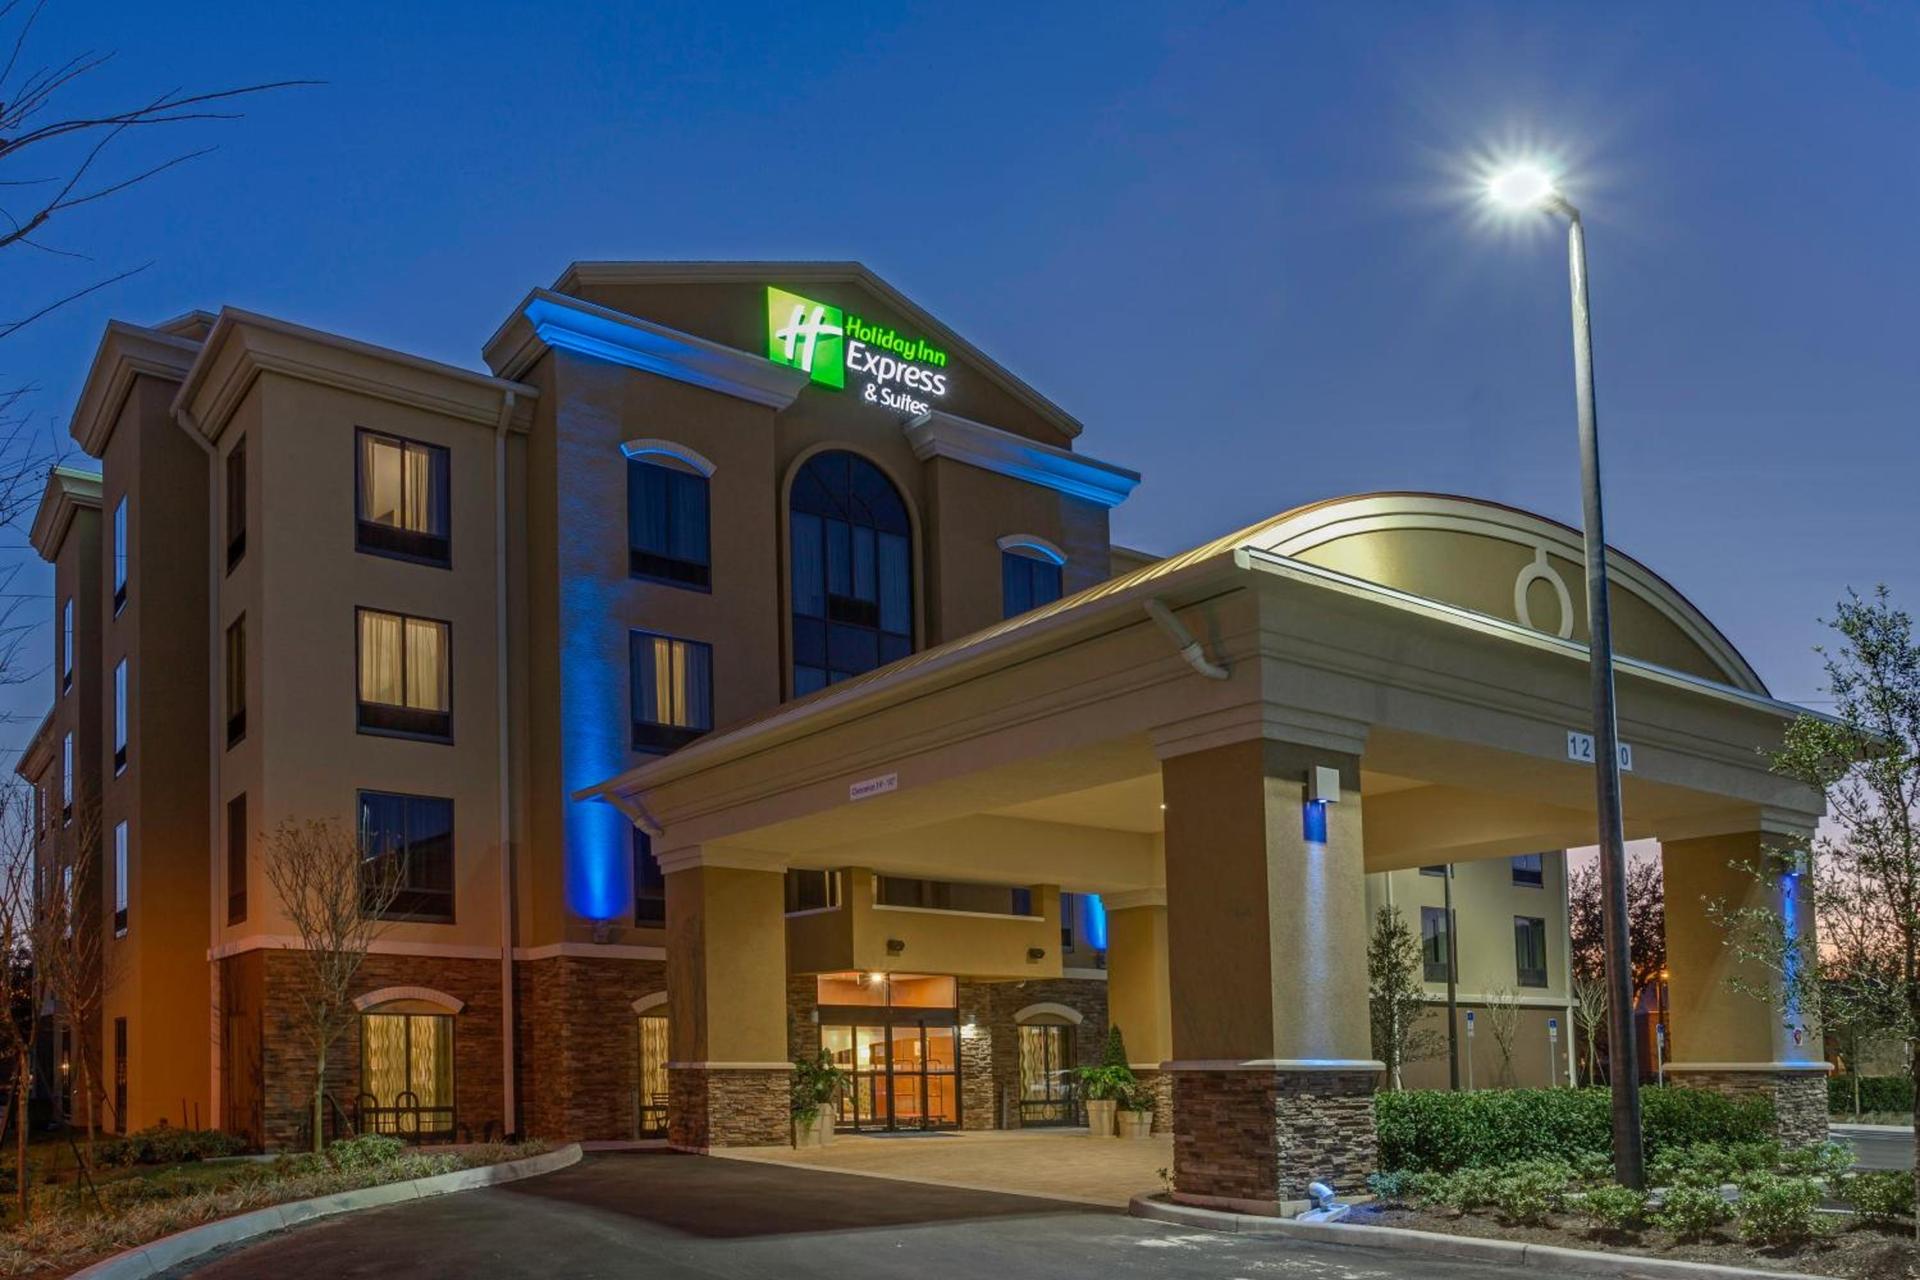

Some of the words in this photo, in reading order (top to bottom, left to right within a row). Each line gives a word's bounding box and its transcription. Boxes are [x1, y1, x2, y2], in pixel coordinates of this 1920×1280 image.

[846, 315, 916, 361] Holiday
[918, 339, 947, 367] Inn
[846, 340, 947, 396] Express
[864, 382, 878, 402] &
[880, 387, 930, 416] Suites
[1570, 735, 1629, 765] 120
